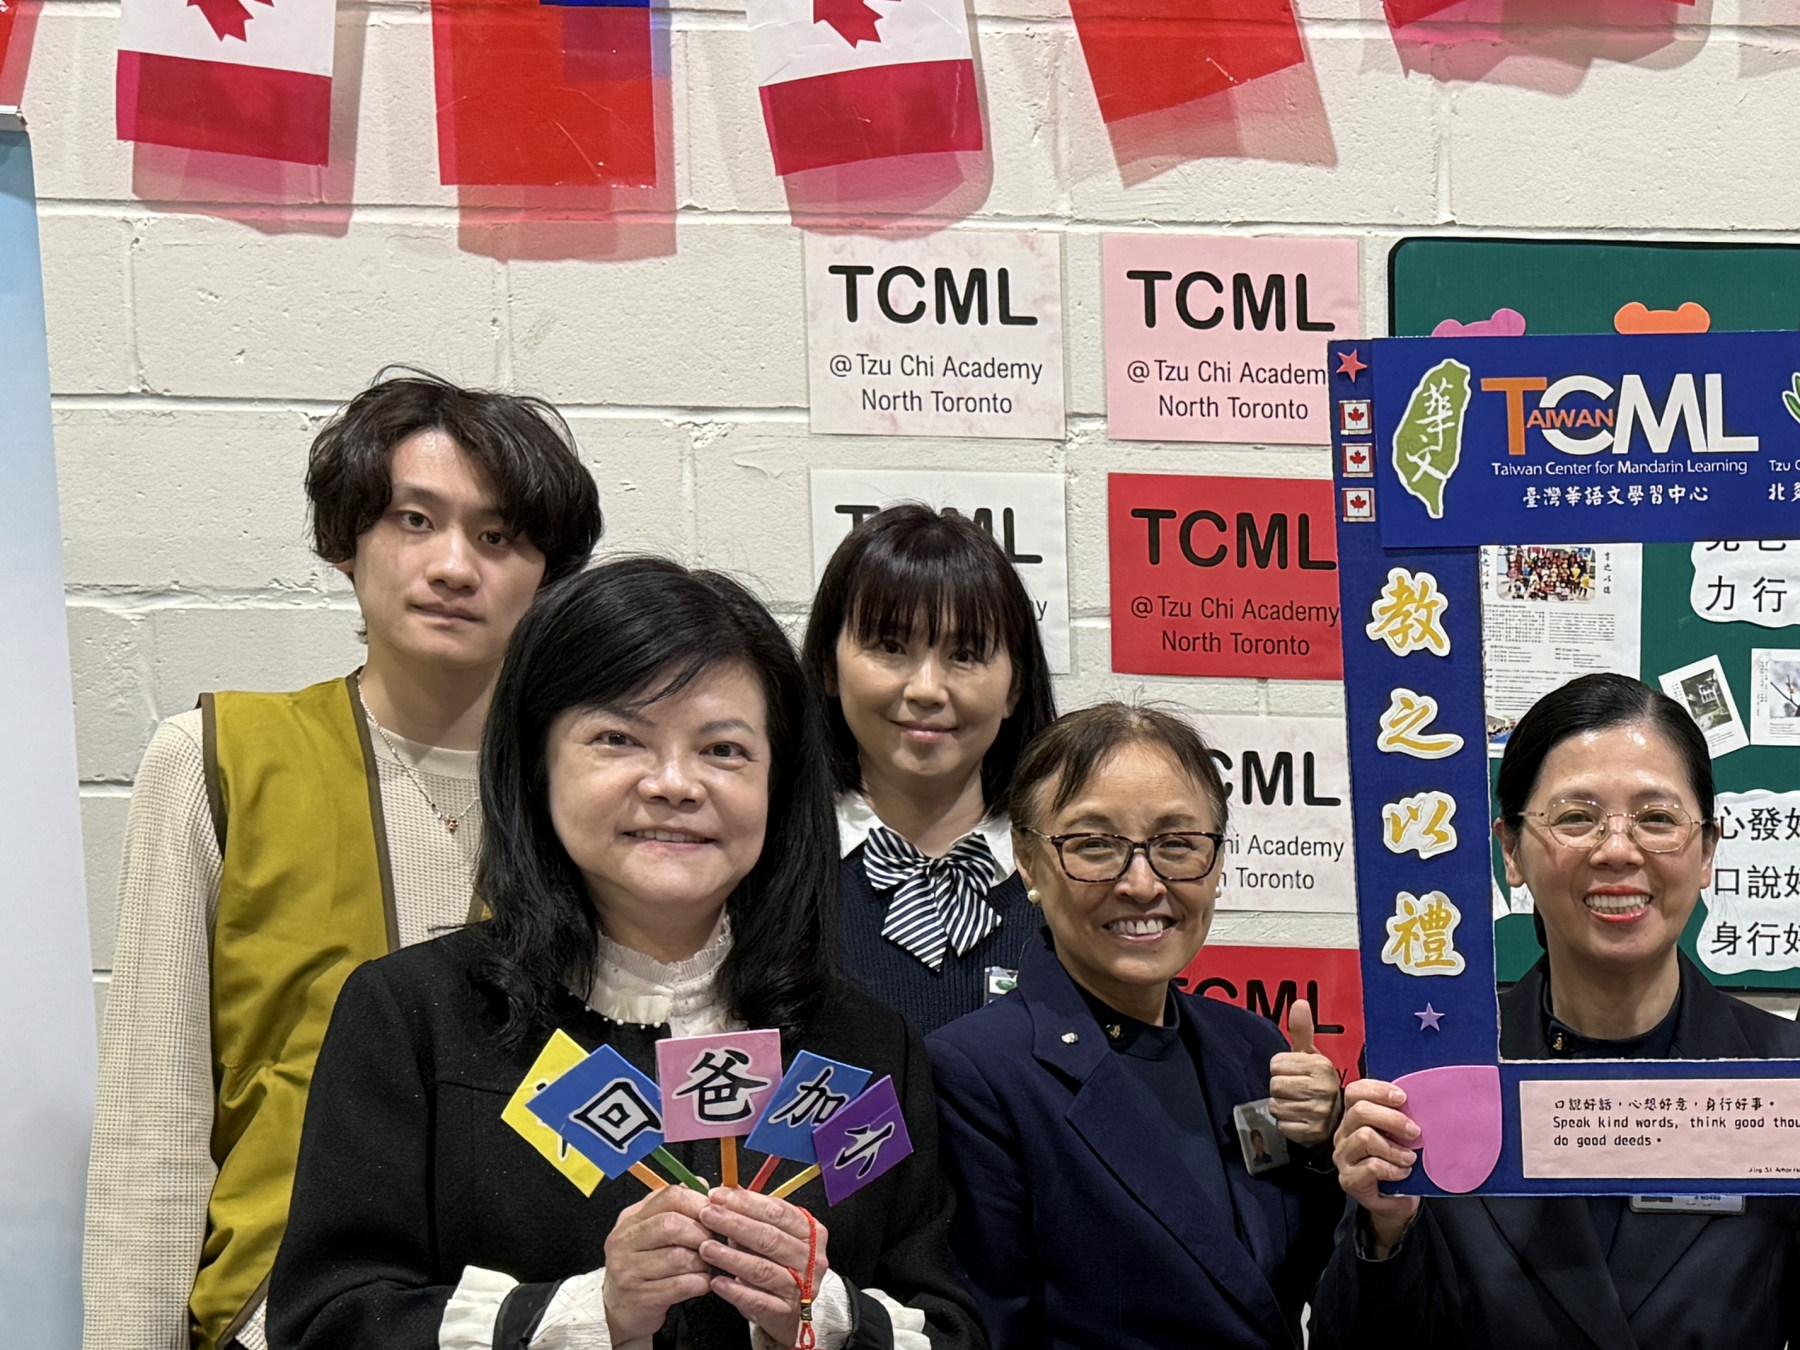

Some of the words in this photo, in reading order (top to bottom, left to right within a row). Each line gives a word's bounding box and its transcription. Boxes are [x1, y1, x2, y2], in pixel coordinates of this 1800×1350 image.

[828, 265, 1038, 326] TCML
[1126, 270, 1335, 332] TCML
[857, 354, 891, 376] Tzu
[901, 355, 934, 377] Chi
[942, 355, 1043, 383] Academy
[1154, 359, 1188, 381] Tzu
[1198, 360, 1231, 383] Chi
[1239, 360, 1328, 384] Academ
[862, 389, 922, 411] North
[930, 390, 1012, 414] Toronto
[1159, 395, 1219, 417] North
[1227, 396, 1308, 420] Toronto
[1491, 462, 1542, 475] Taiwan
[1545, 462, 1592, 475] Center
[1595, 460, 1614, 474] for
[1618, 460, 1684, 473] Mandarin
[1687, 459, 1747, 475] Learning
[1769, 460, 1791, 471] Tzu
[1523, 484, 1708, 508] 臺灣華語文學習中心
[1131, 508, 1337, 570] TCML
[1157, 595, 1191, 618] Tzu
[1201, 597, 1233, 619] Chi
[1242, 597, 1340, 625] Academy
[1162, 630, 1221, 653] North
[1230, 632, 1310, 655] Toronto
[1373, 574, 1457, 968] 教之以禮
[1247, 834, 1344, 862] Academy
[1235, 867, 1314, 889] Toronto
[677, 1049, 769, 1122] 爸
[773, 1068, 848, 1128] 加
[574, 1081, 662, 1151] 回
[1553, 1116, 1590, 1129] Speak
[1598, 1116, 1628, 1128] kind
[1636, 1116, 1678, 1129] words,
[1690, 1116, 1726, 1128] think
[1735, 1117, 1764, 1130] good
[1554, 1135, 1568, 1146] do
[1577, 1135, 1606, 1148] good
